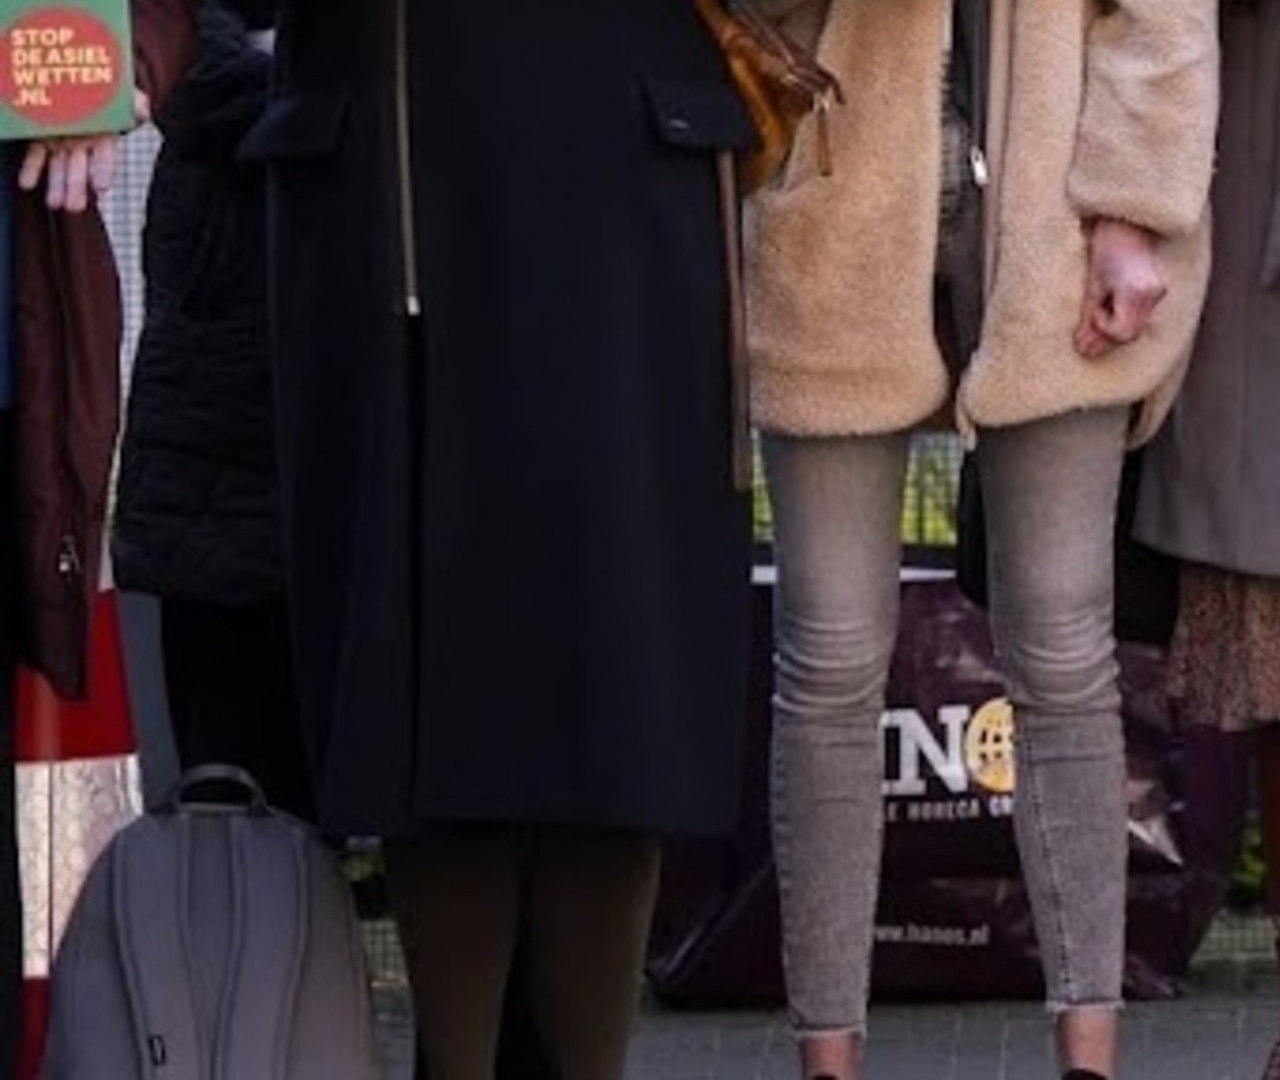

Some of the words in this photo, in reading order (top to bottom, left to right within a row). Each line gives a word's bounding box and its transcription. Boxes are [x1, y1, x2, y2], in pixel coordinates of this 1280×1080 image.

[11, 28, 75, 46] STOP
[11, 48, 42, 66] DE
[45, 45, 111, 64] ASIEL
[12, 67, 112, 85] WETTEN
[13, 87, 53, 107] .NL
